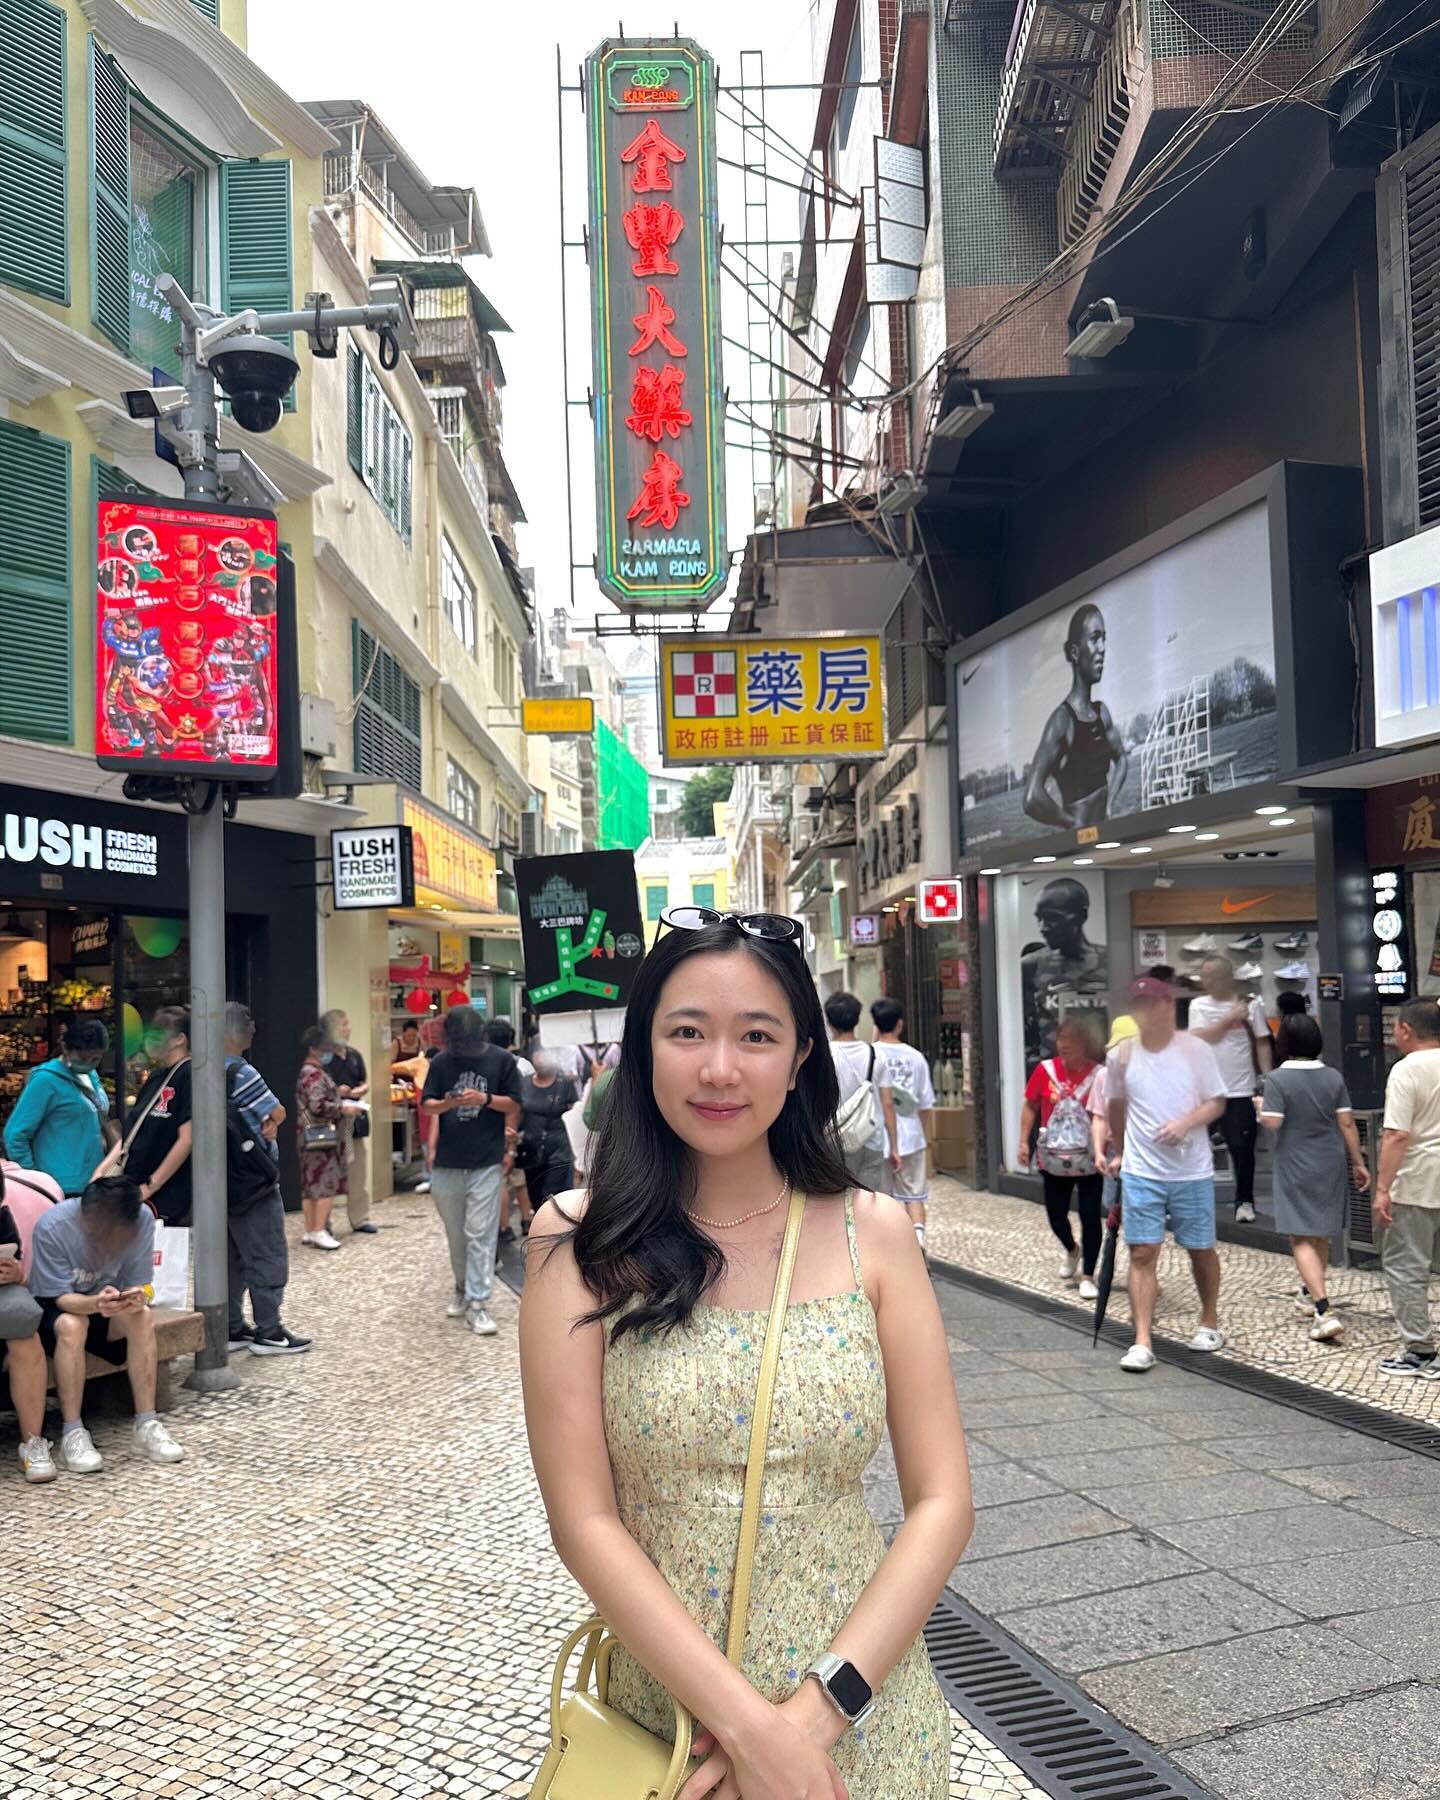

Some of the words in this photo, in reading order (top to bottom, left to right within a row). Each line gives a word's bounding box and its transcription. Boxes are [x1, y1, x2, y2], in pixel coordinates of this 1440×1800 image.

[619, 559, 659, 577] KAM
[746, 648, 871, 716] 藥房
[0, 813, 103, 870] USH
[106, 829, 158, 853] FRESH
[338, 837, 395, 857] LUSH
[106, 847, 158, 864] HANDMADE
[106, 859, 158, 876] COSMETICS
[339, 857, 396, 877] FRESH
[340, 874, 397, 889] HANDMADE
[340, 886, 398, 899] COSMETICS
